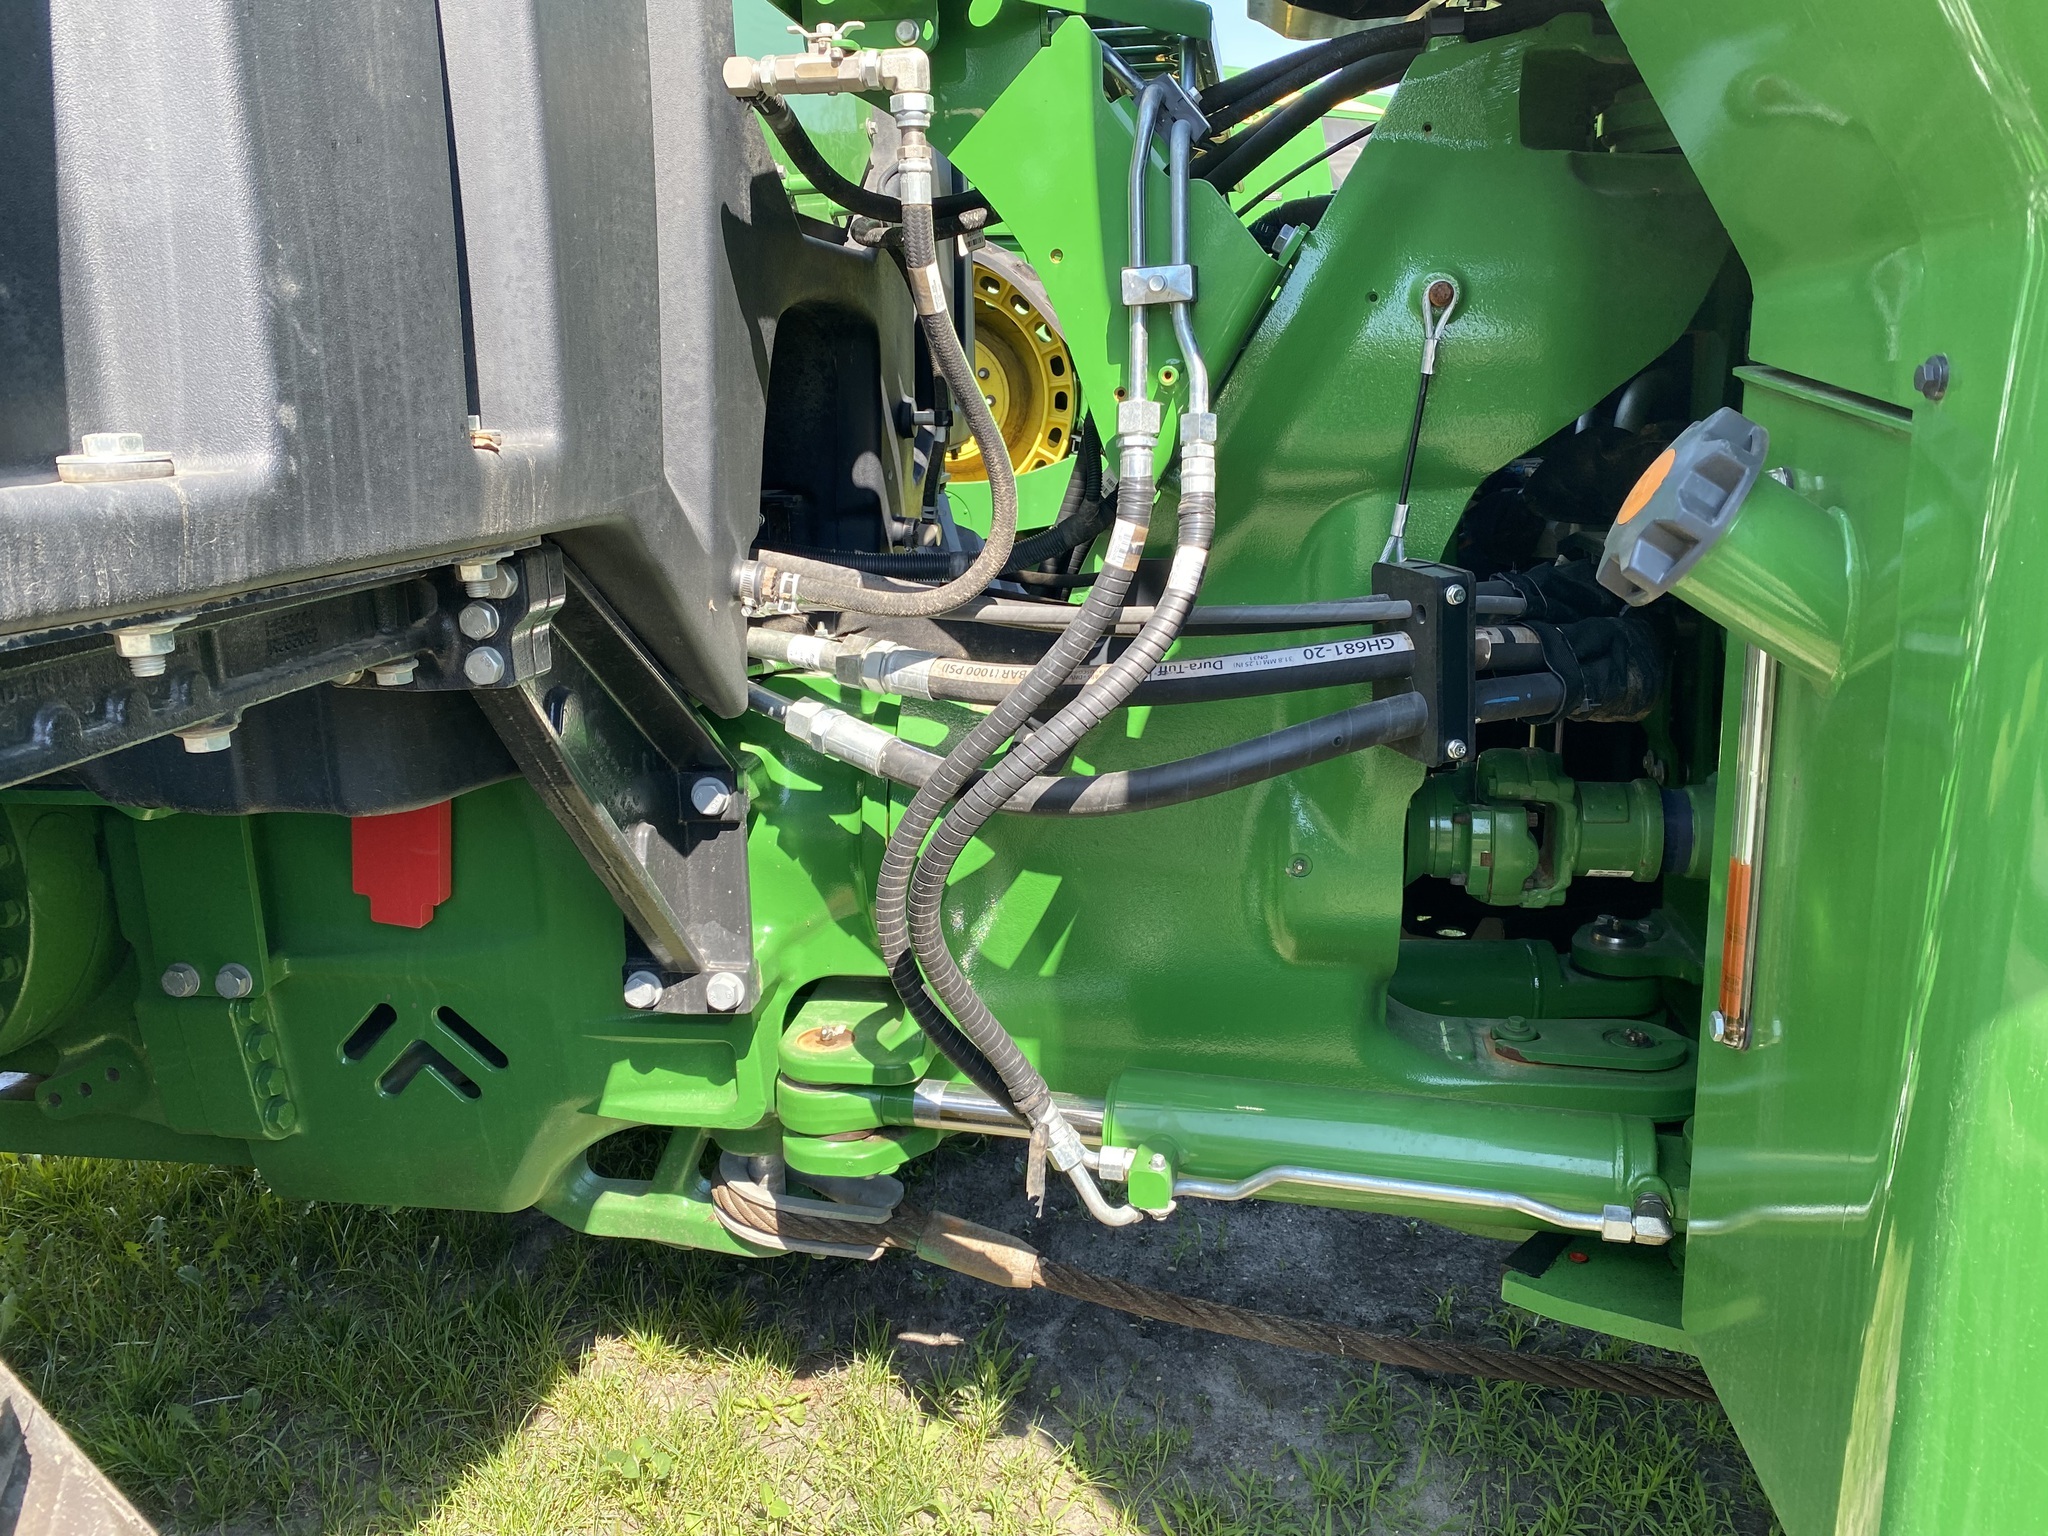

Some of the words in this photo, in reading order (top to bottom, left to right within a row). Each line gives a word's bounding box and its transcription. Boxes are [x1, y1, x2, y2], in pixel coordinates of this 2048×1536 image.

[1303, 637, 1395, 660] GH681-20
[942, 663, 965, 675] PSI)
[966, 666, 1000, 678] (1000
[1001, 669, 1028, 680] BAR
[1157, 660, 1223, 677] Dura-Tuff
